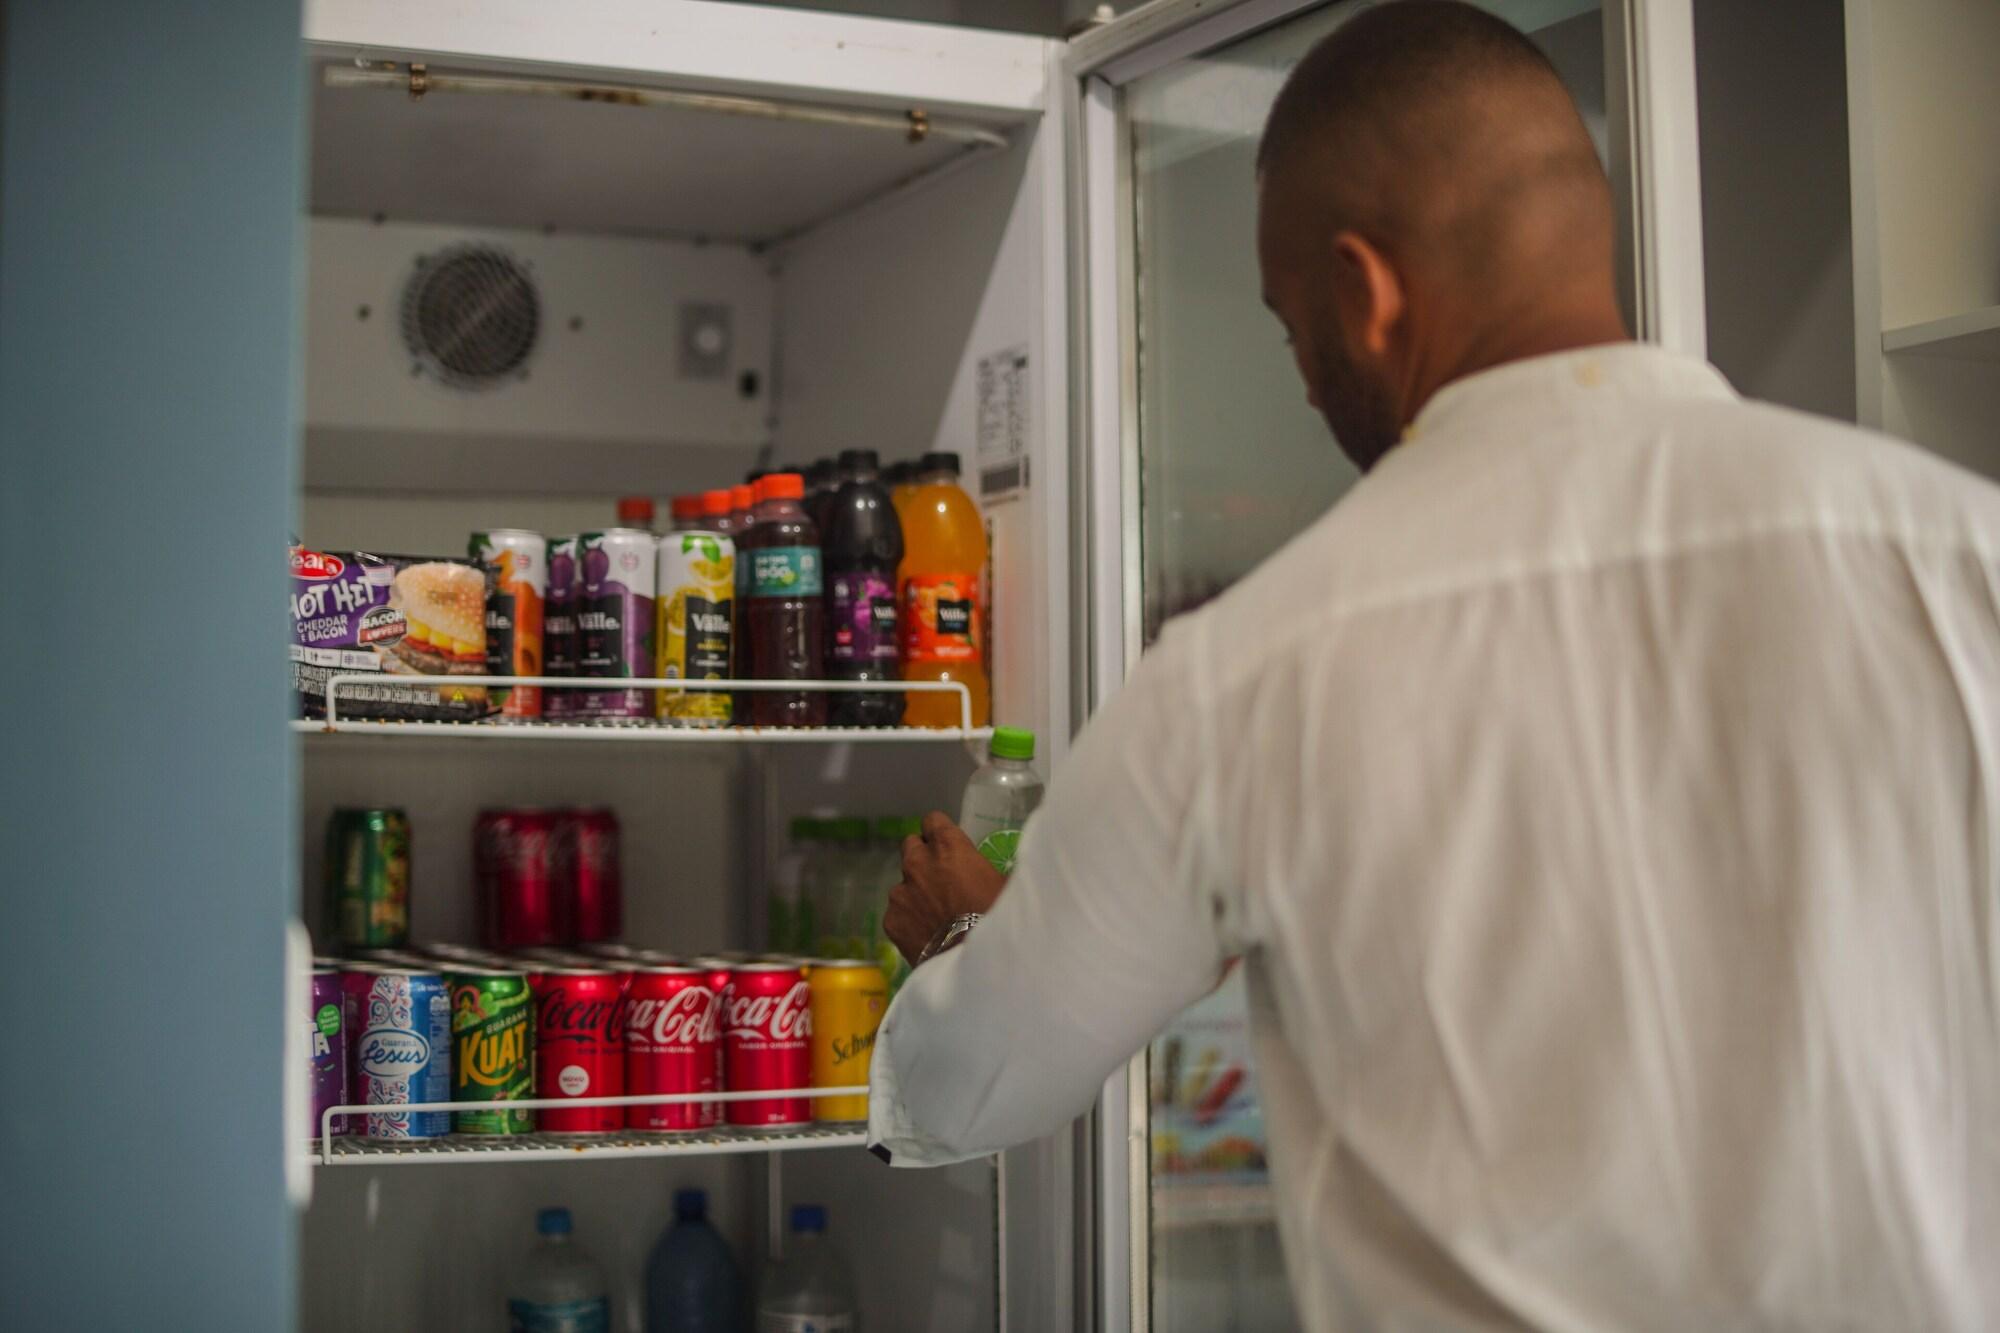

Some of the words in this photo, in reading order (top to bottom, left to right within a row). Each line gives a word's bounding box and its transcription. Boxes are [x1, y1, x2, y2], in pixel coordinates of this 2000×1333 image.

[331, 576, 375, 613] HIT
[296, 614, 349, 634] CHEDDAR
[308, 625, 348, 642] BACON
[359, 1039, 424, 1065] Jesus
[460, 1020, 528, 1089] KUAT
